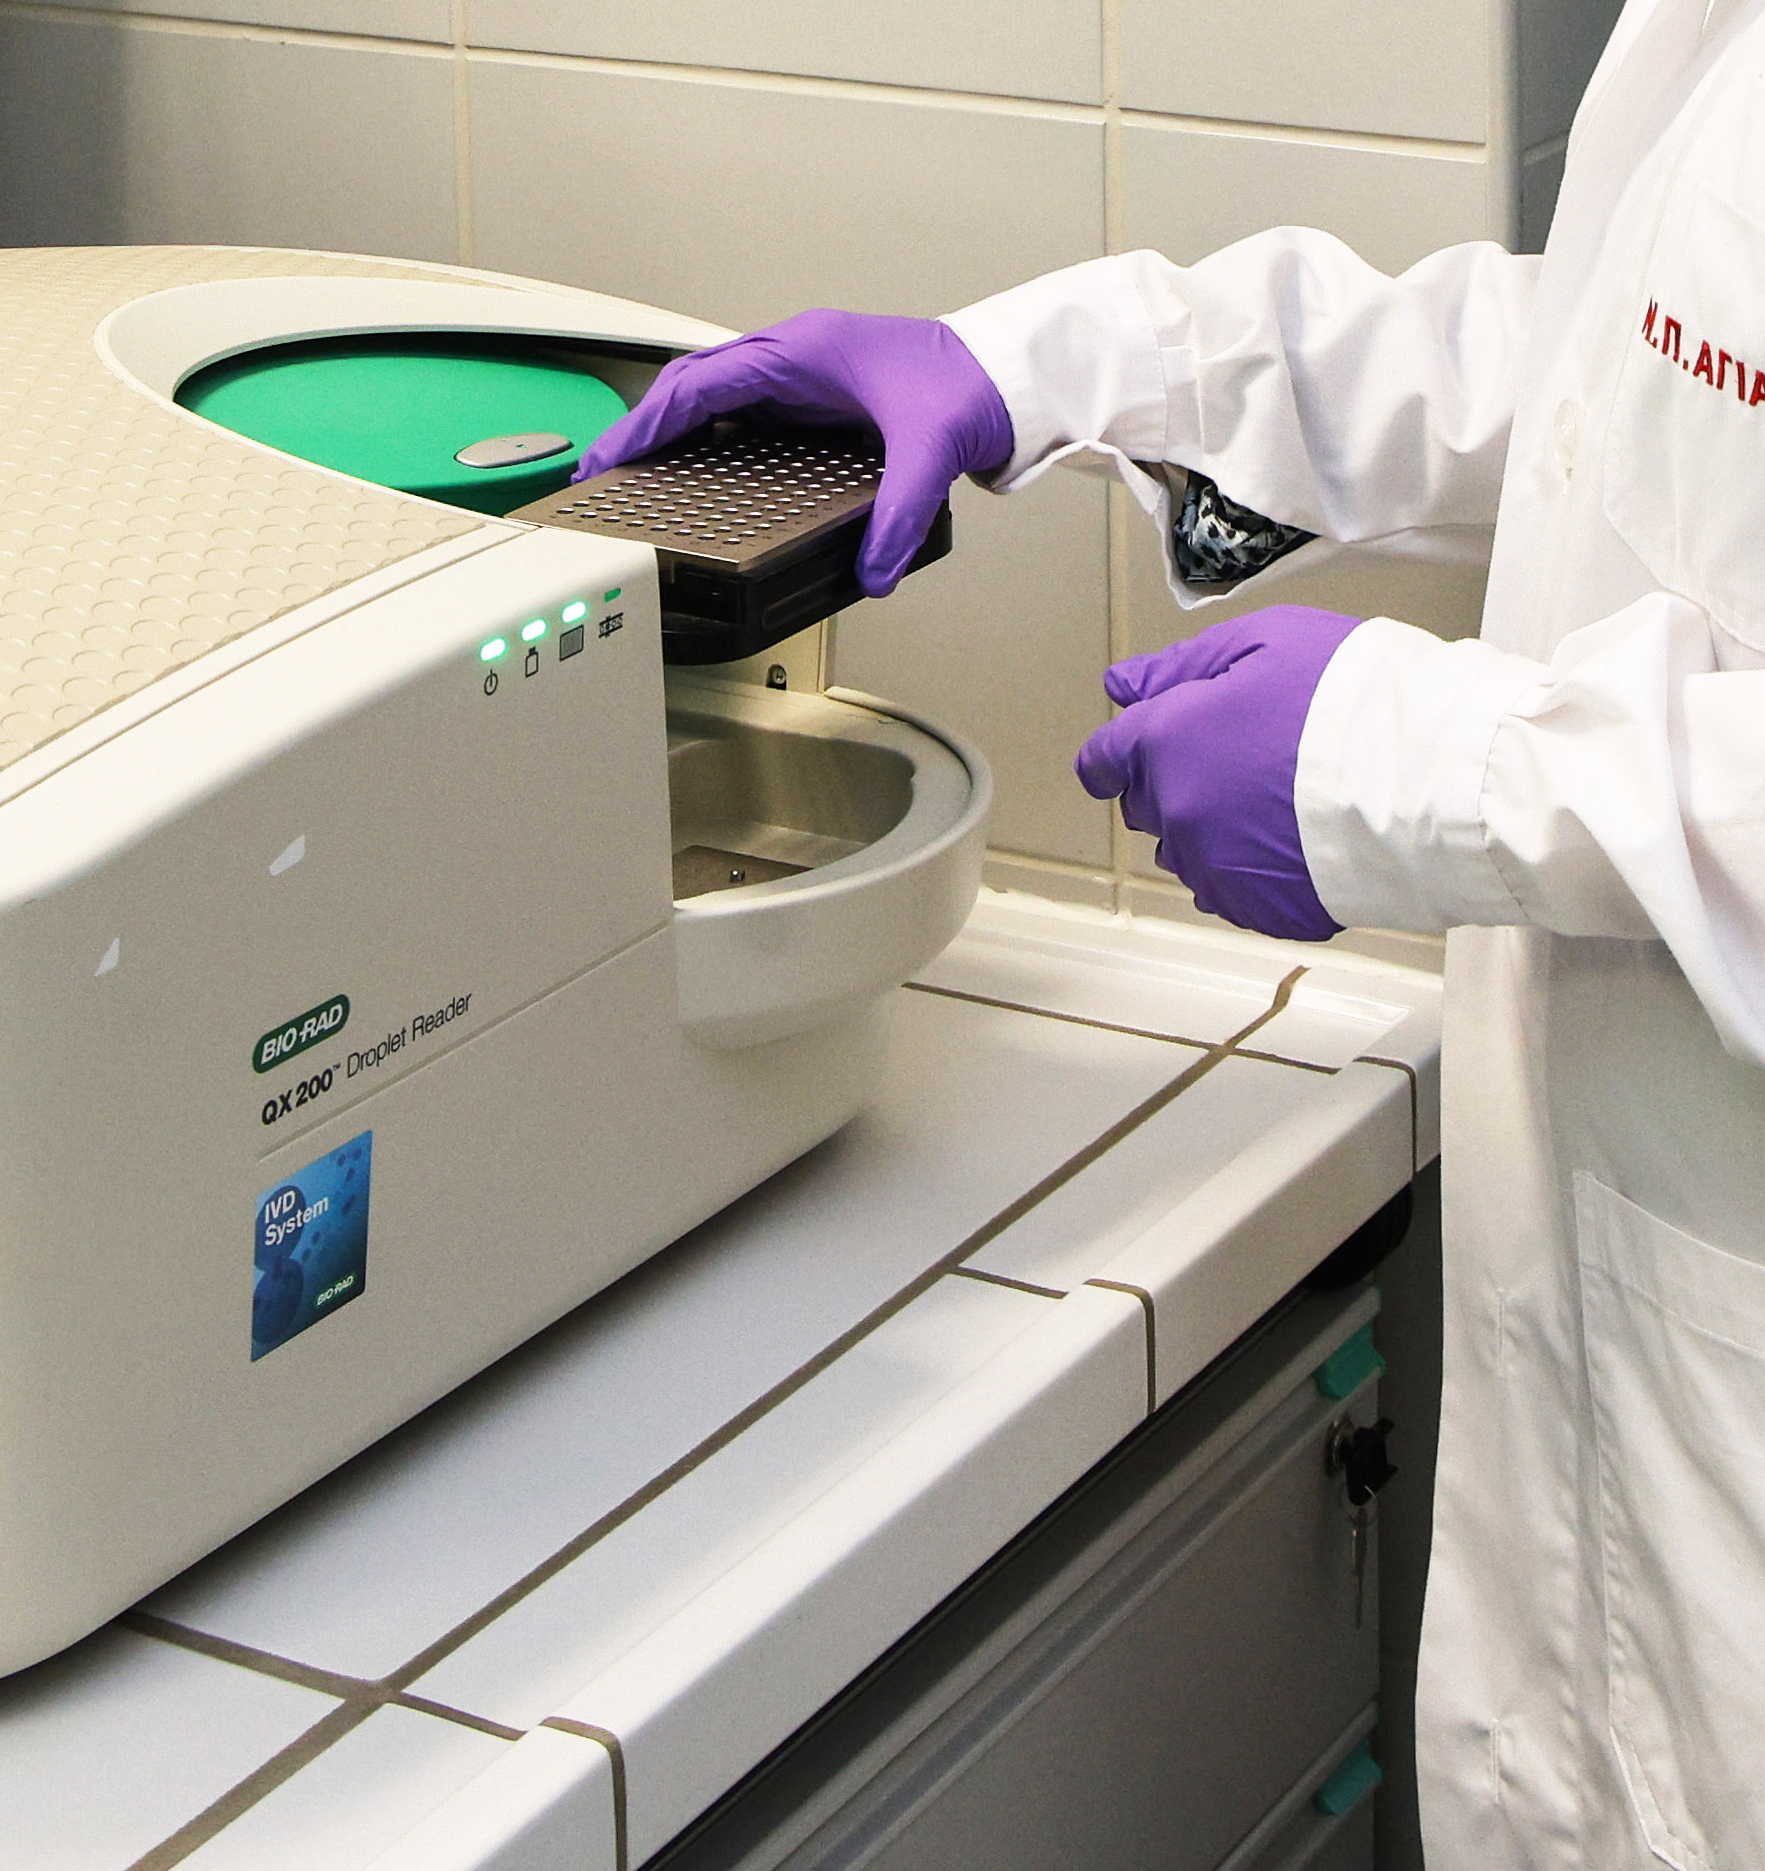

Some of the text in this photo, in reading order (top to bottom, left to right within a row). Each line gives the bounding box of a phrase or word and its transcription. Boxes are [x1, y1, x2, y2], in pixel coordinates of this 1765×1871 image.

[260, 1003, 343, 1065] BIO-RAD
[347, 1027, 407, 1079] Droplet
[412, 993, 473, 1042] Reader
[264, 1189, 297, 1224] IVD
[264, 1196, 330, 1247] System
[316, 1275, 354, 1306] BIO-RAD
